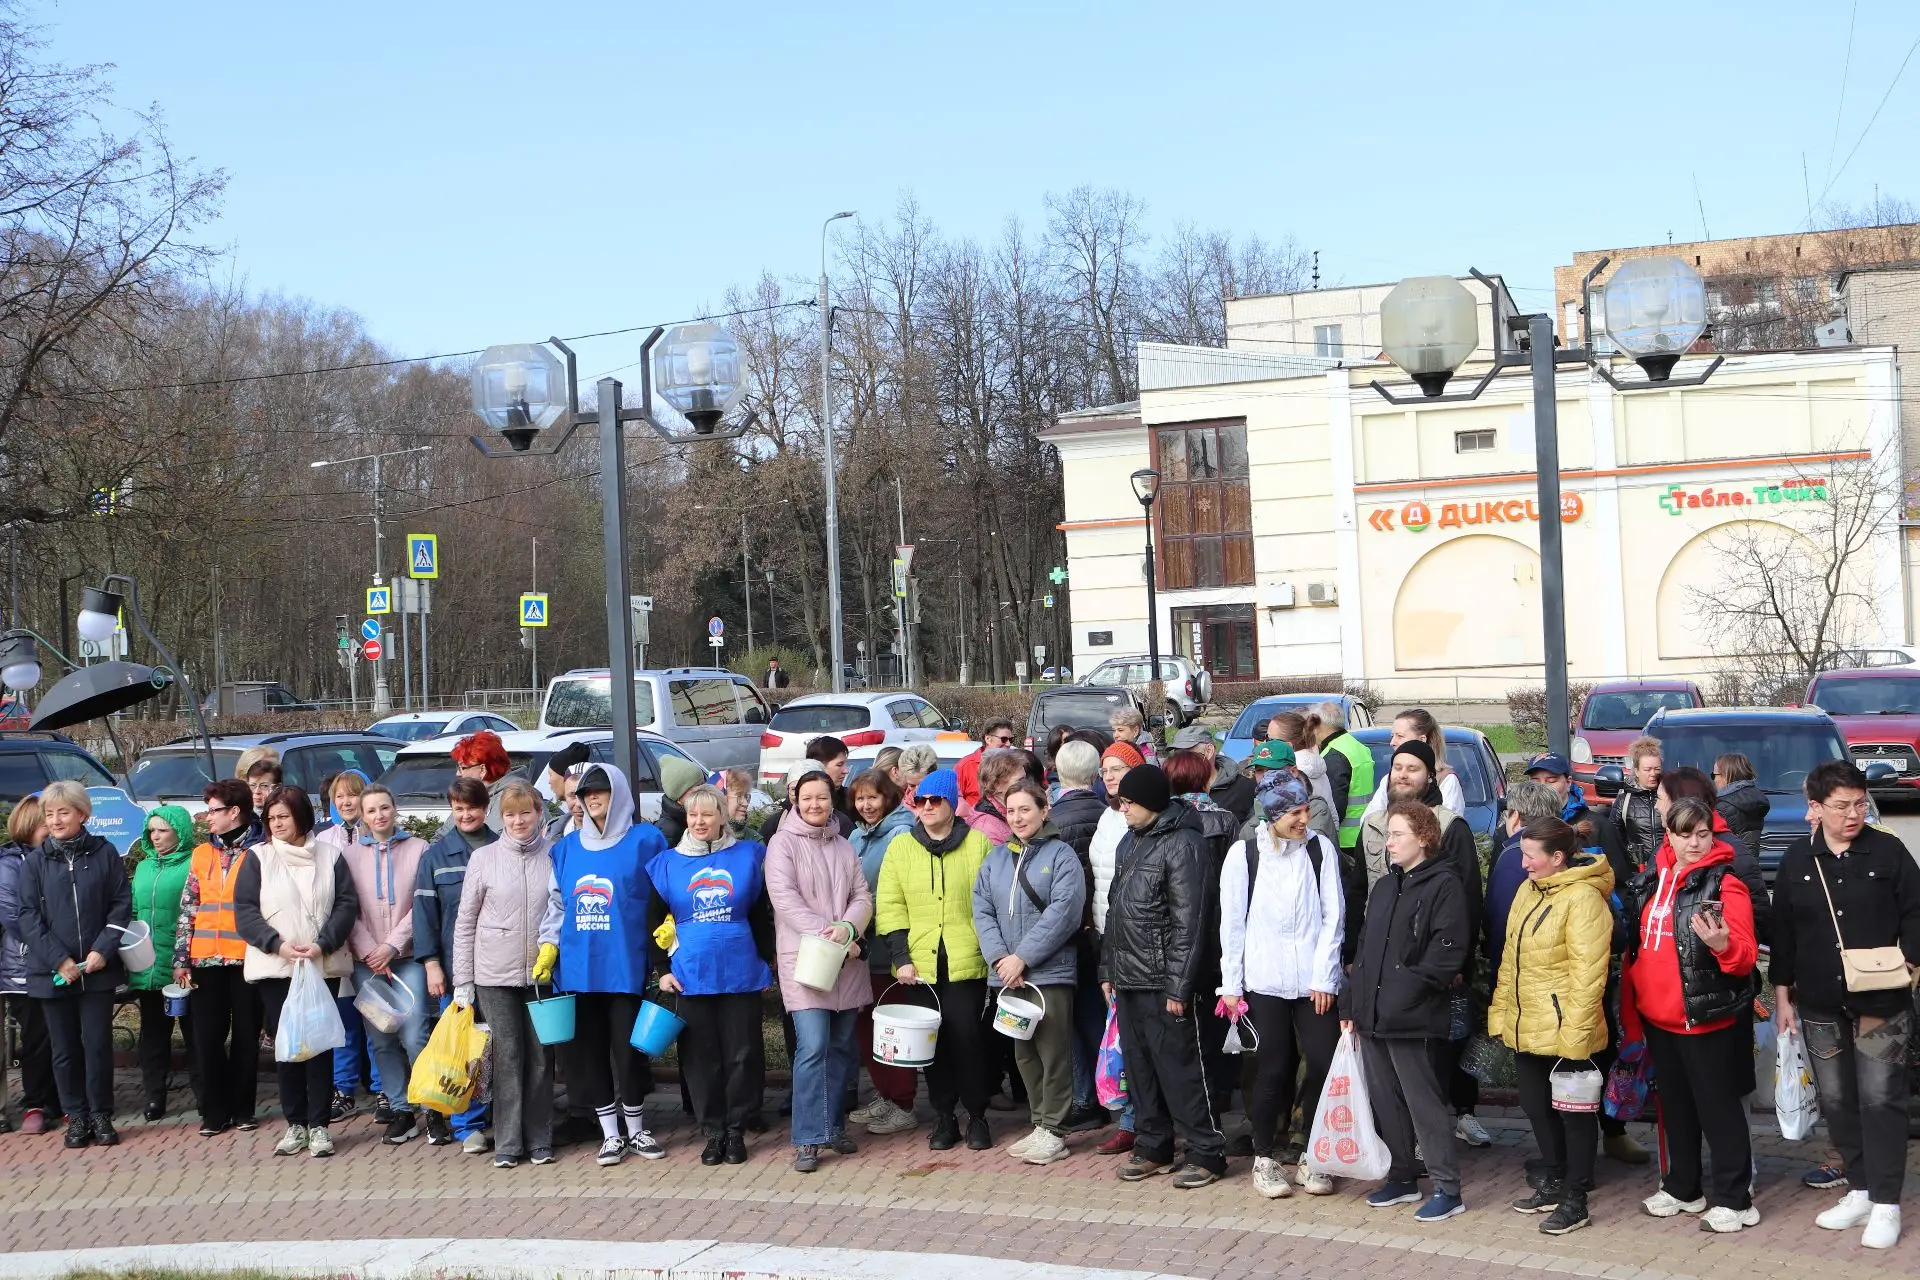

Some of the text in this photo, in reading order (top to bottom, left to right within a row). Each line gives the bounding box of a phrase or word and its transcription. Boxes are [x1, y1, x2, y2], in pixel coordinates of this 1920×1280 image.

[1560, 498, 1577, 510] 24
[87, 816, 123, 829] Пущино
[575, 915, 610, 923] ЕДИНАЯ
[576, 922, 610, 931] РОССИЯ
